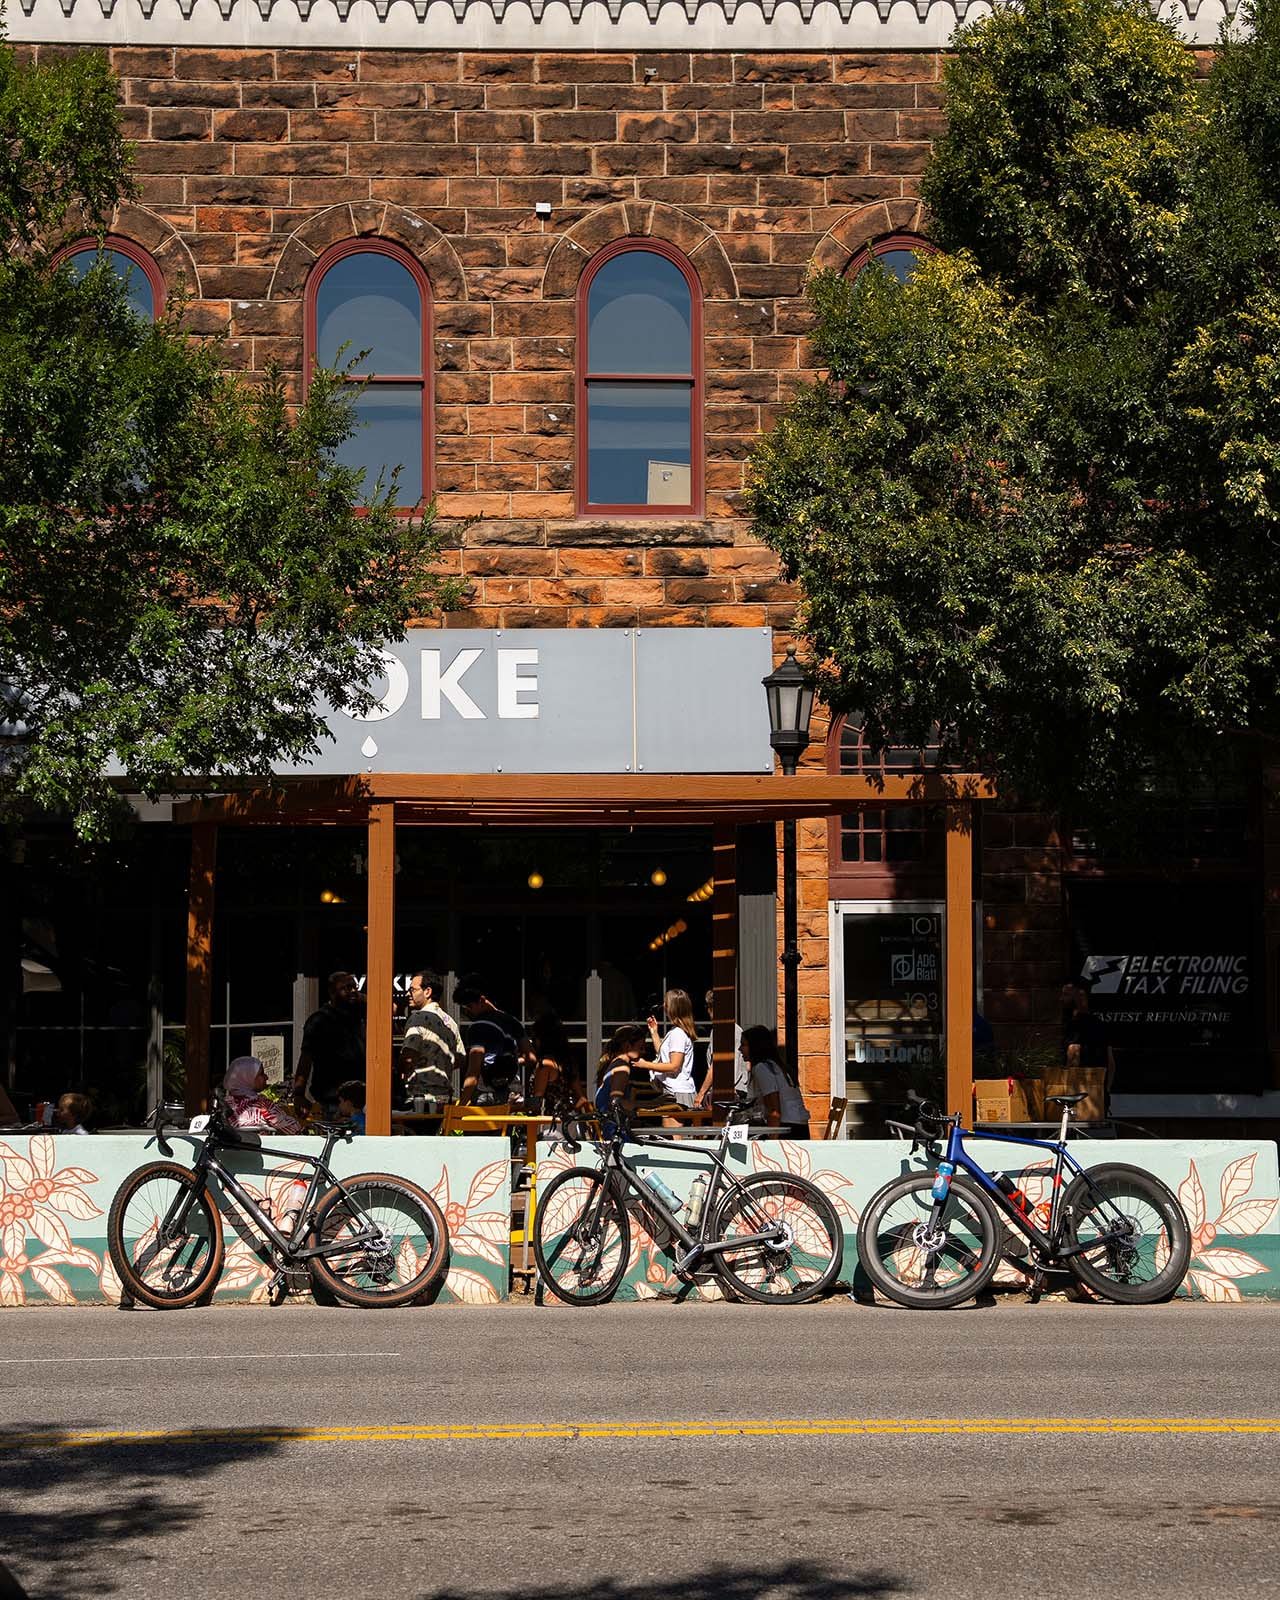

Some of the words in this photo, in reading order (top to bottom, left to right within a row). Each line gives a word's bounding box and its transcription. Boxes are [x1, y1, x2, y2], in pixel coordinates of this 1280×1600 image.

[278, 647, 541, 722] OKE
[909, 916, 937, 935] 101
[916, 953, 936, 967] ADG
[1128, 955, 1247, 973] ELECTRONIC
[1124, 976, 1170, 994] TAX
[1179, 976, 1249, 994] FILING
[904, 992, 938, 1010] 103
[1092, 1011, 1143, 1022] ASTEST
[1146, 1011, 1197, 1022] REFUND
[1200, 1011, 1232, 1022] TIME
